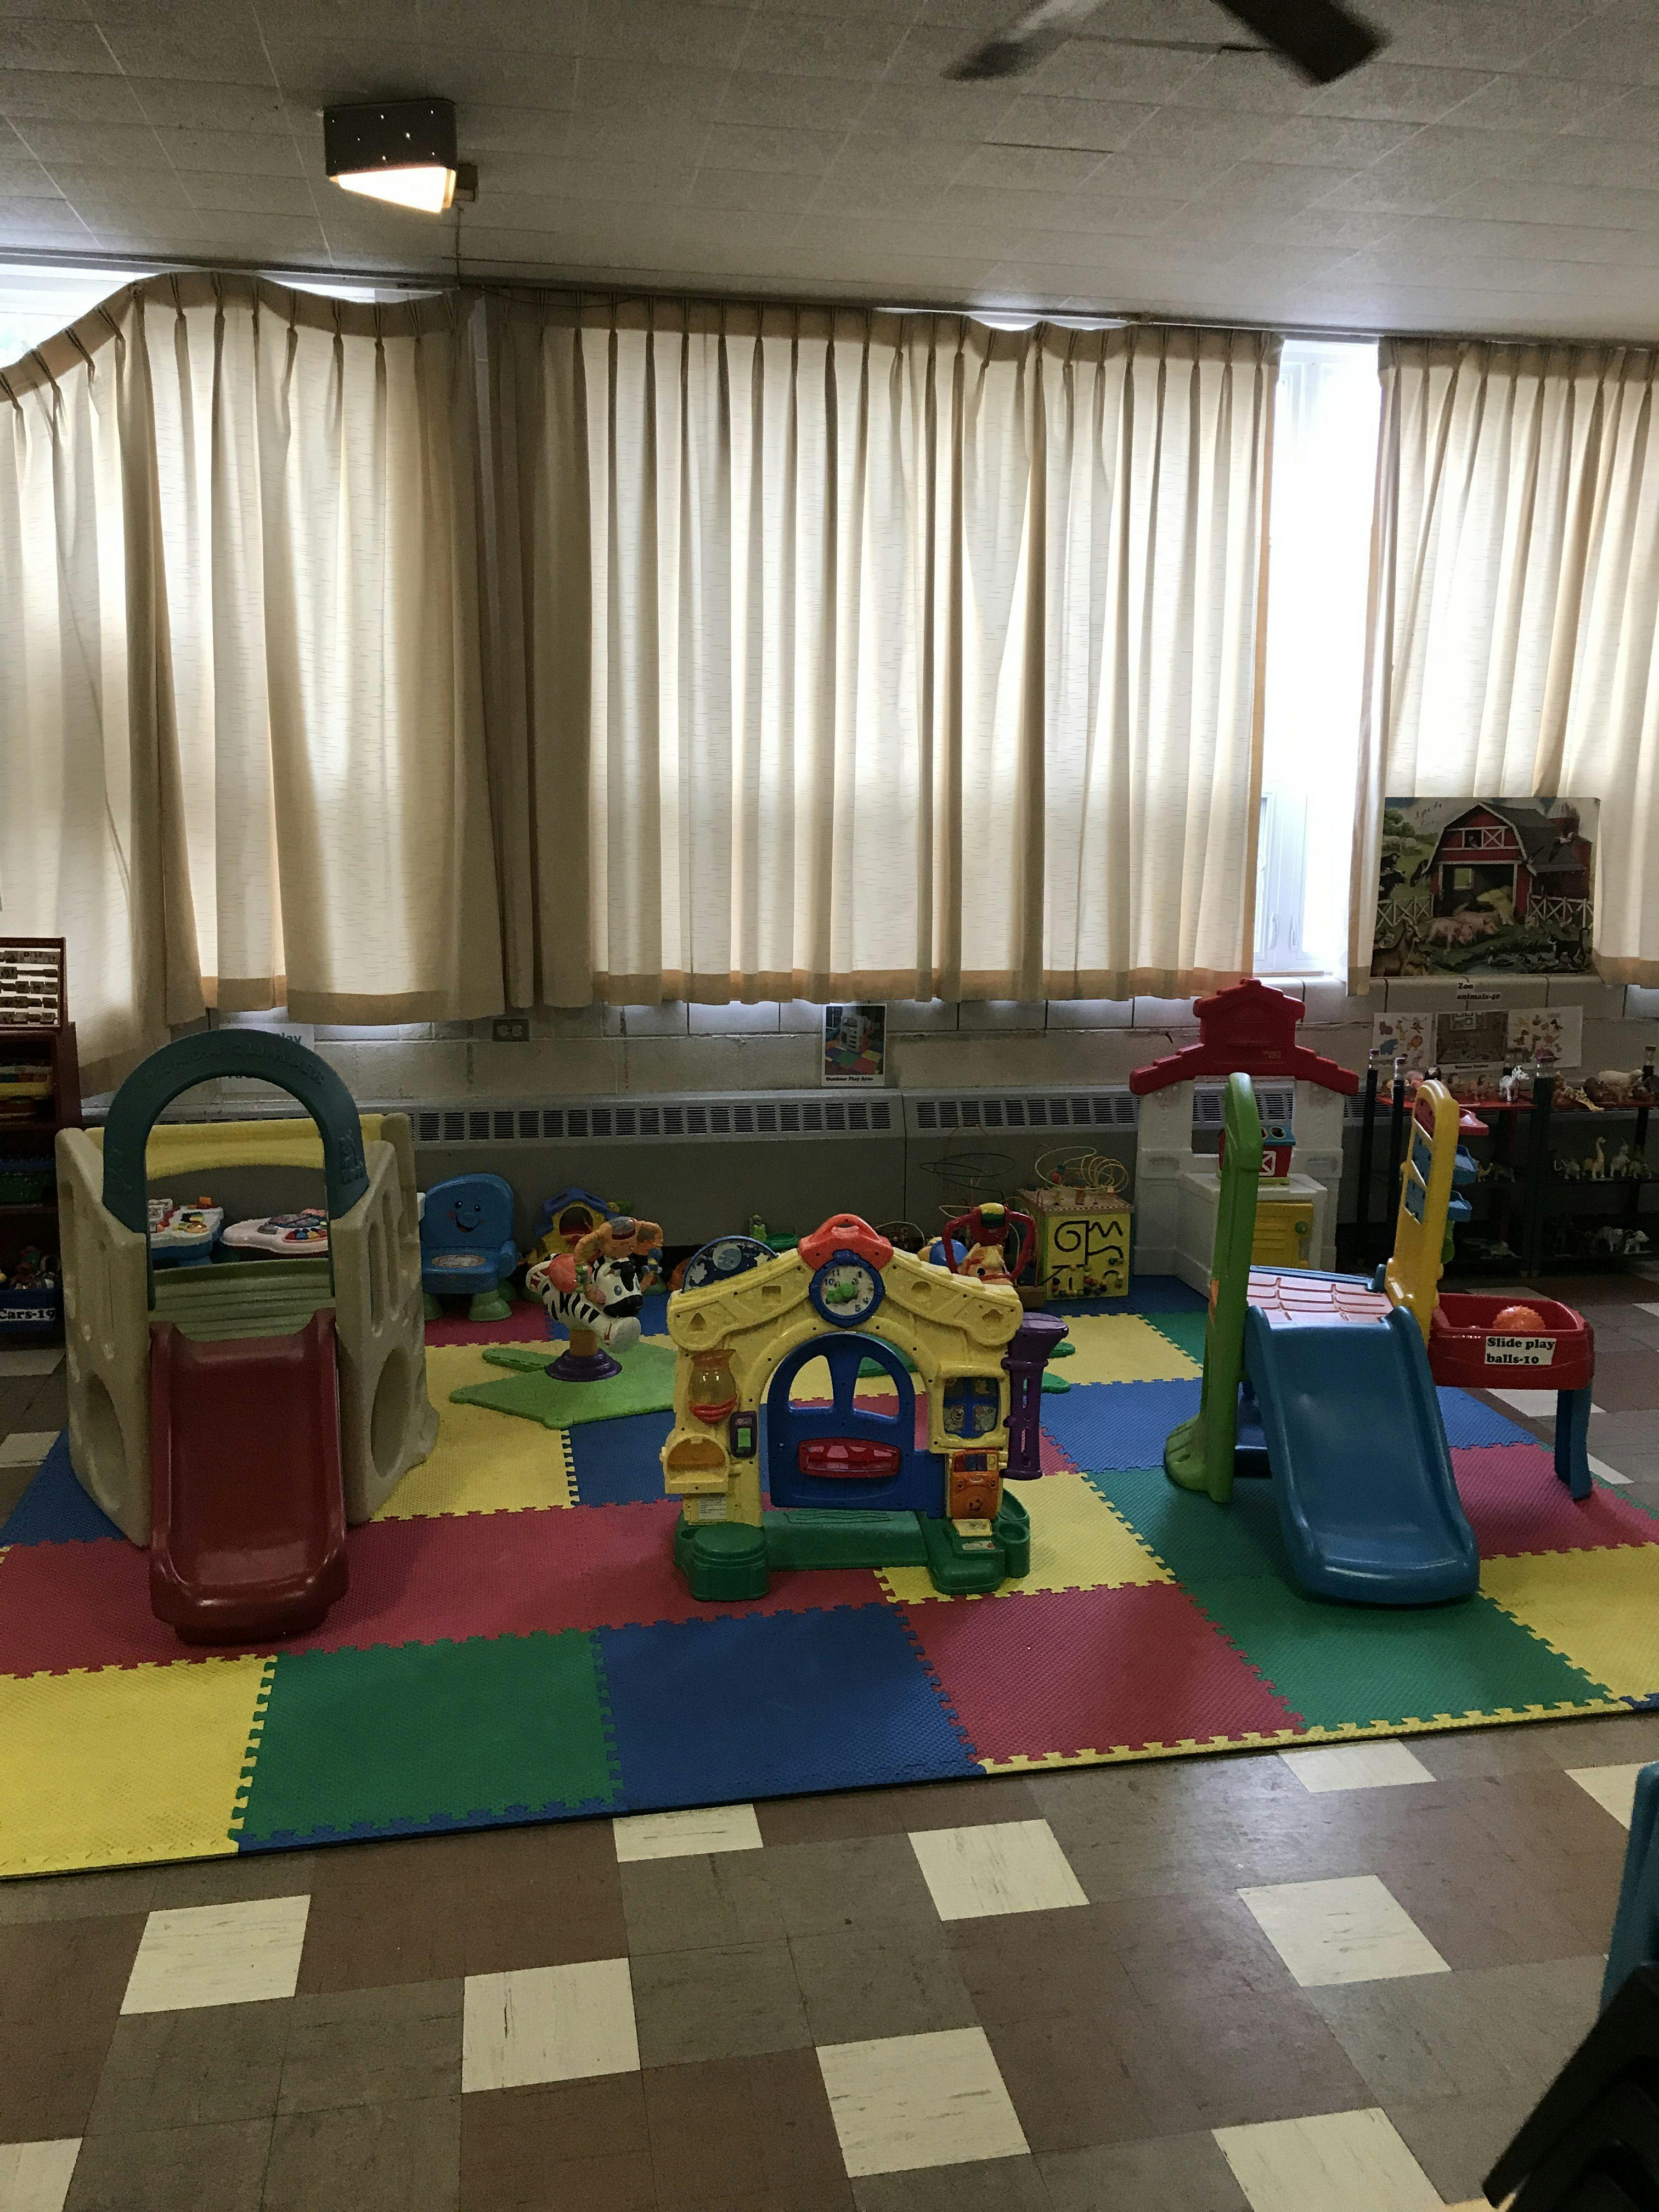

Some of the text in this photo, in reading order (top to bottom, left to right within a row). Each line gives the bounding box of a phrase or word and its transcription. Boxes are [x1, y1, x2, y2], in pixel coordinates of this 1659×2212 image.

[0, 1310, 55, 1319] Cars-19
[1487, 1337, 1556, 1351] Slide play
[1487, 1353, 1539, 1364] balls-10
